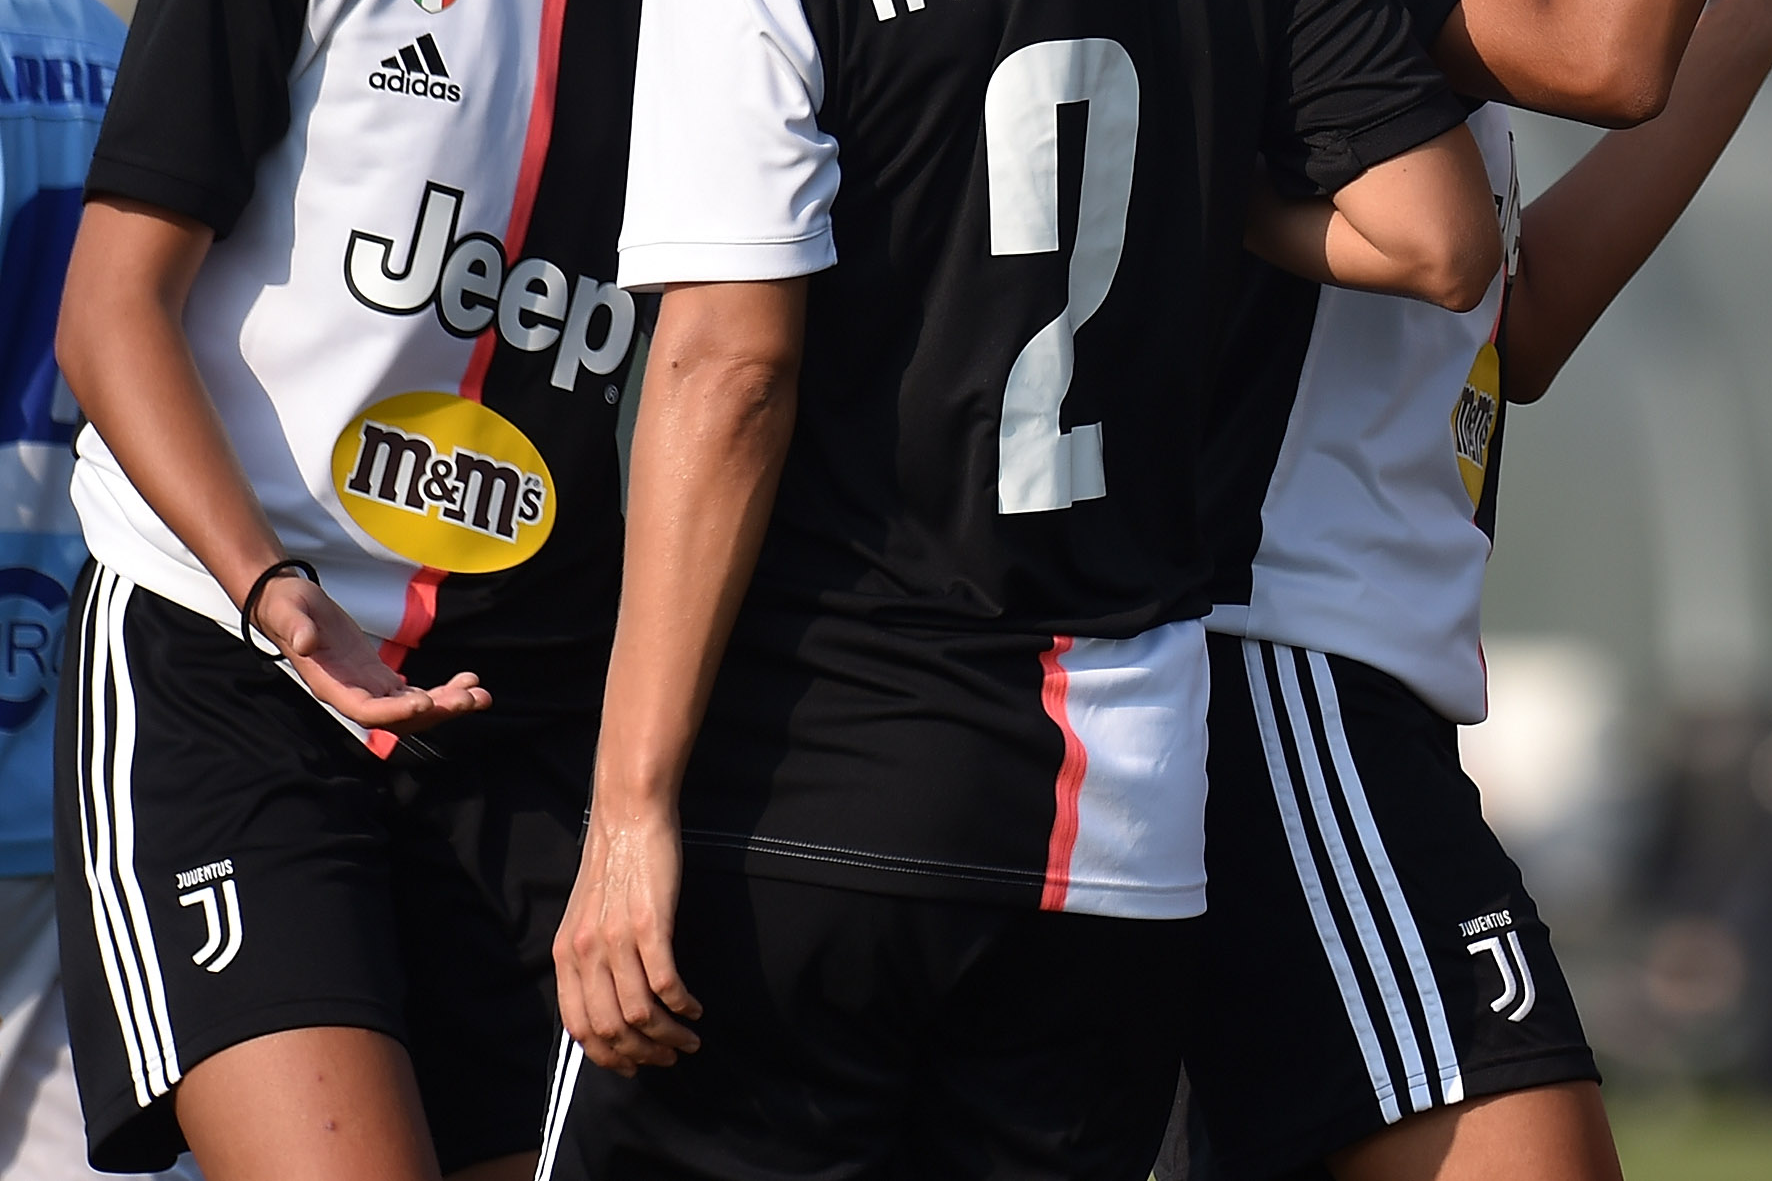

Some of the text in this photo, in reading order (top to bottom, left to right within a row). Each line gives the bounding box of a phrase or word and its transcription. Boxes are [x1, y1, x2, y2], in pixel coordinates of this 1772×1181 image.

[368, 69, 461, 103] adidas
[345, 180, 636, 392] Jeep
[985, 38, 1140, 515] 2
[175, 859, 234, 890] JUVENTUS
[1458, 909, 1513, 938] JUVENTUS
